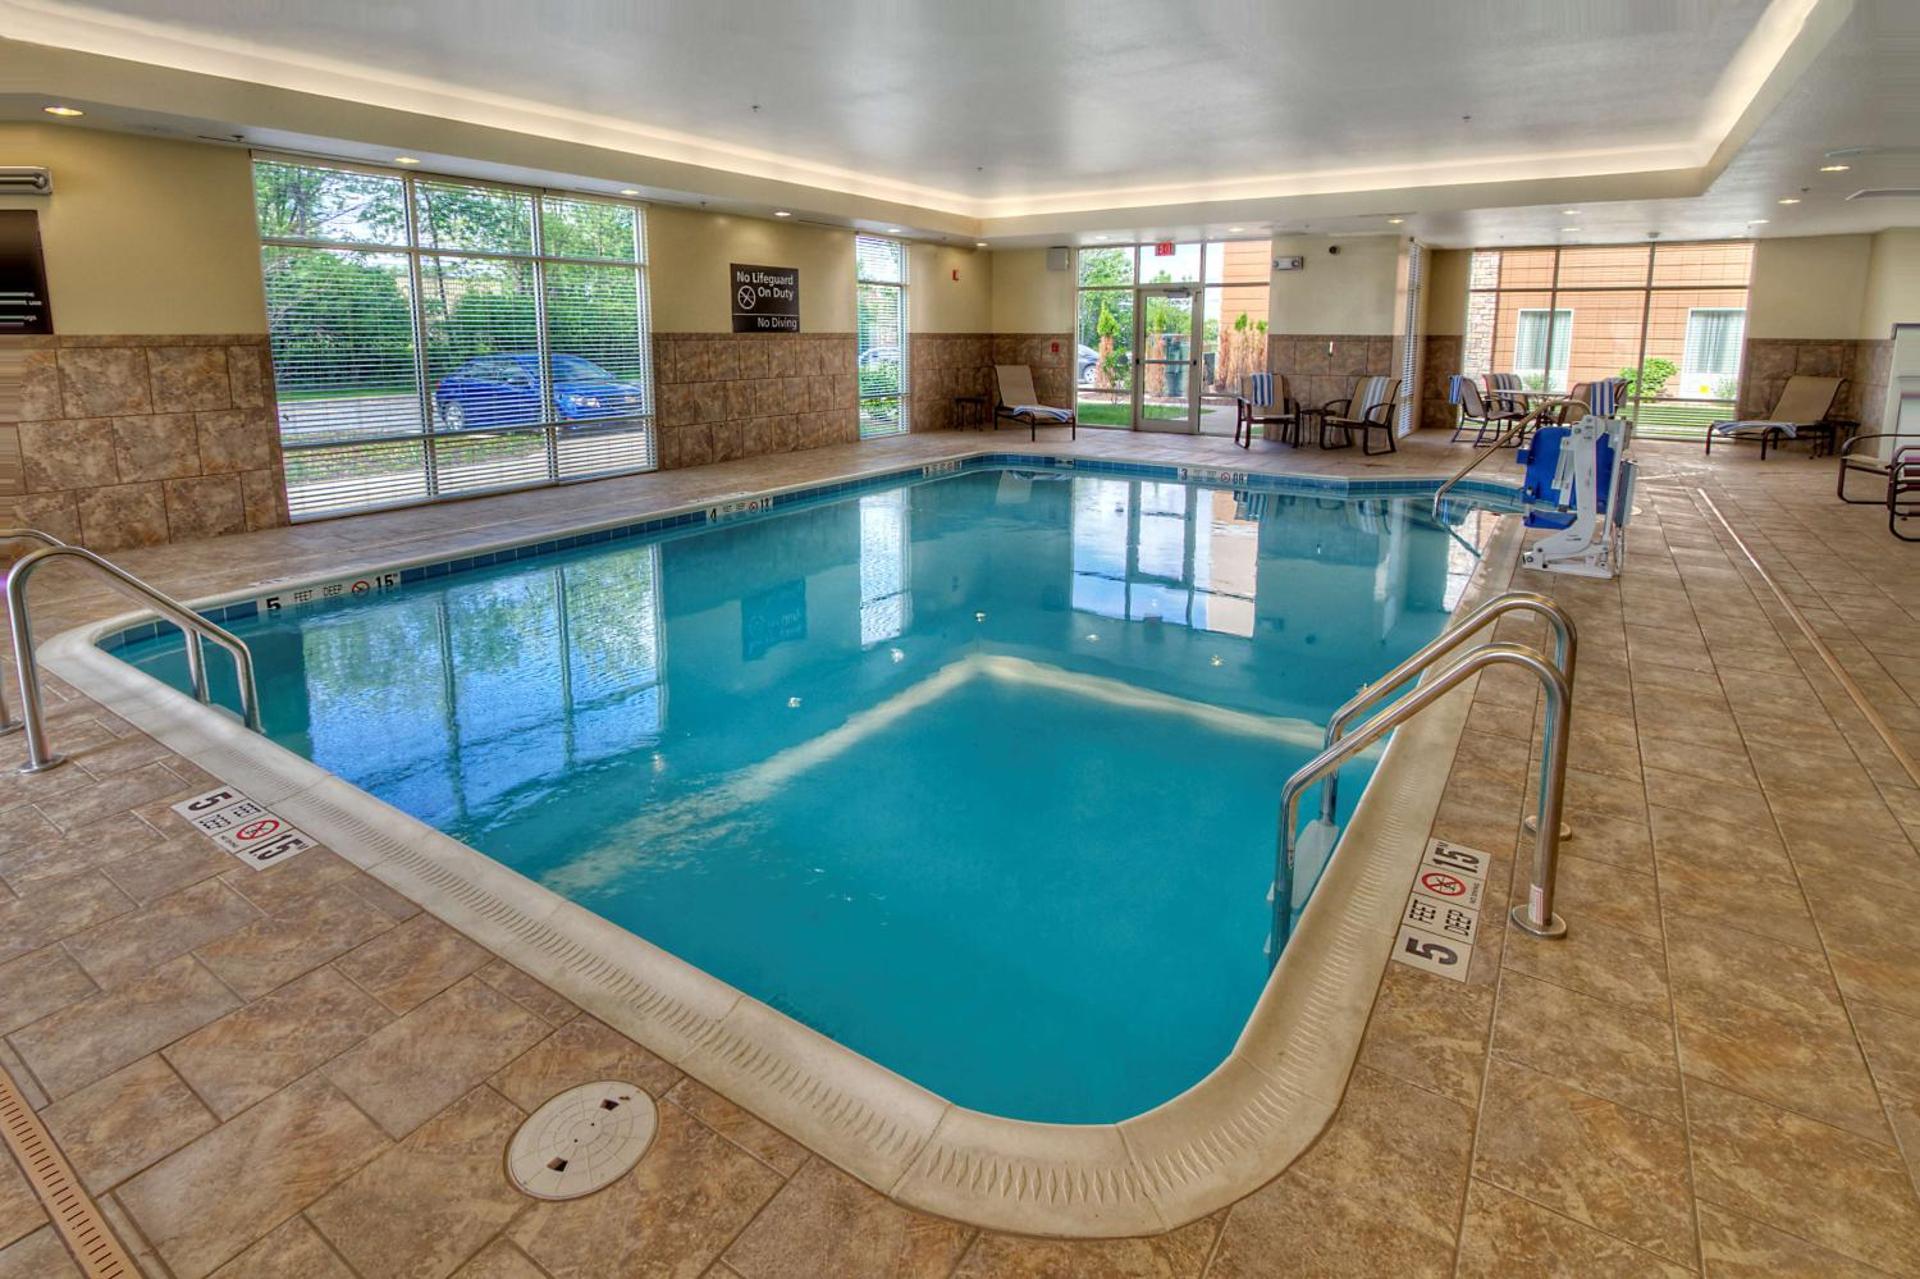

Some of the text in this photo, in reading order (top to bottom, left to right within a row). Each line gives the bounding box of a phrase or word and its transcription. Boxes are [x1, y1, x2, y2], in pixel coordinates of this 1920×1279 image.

[736, 271, 793, 287] No Lifeguard
[758, 286, 793, 301] On Duty
[757, 317, 797, 331] No Diving
[266, 597, 281, 609] 5
[294, 590, 313, 603] FEET
[323, 584, 343, 597] DEEP
[188, 791, 233, 811] 5
[230, 802, 262, 818] FEET
[199, 814, 232, 830] DEEP
[1409, 899, 1437, 925] FEET
[1444, 909, 1472, 936] DEEP
[1405, 937, 1458, 966] 5
